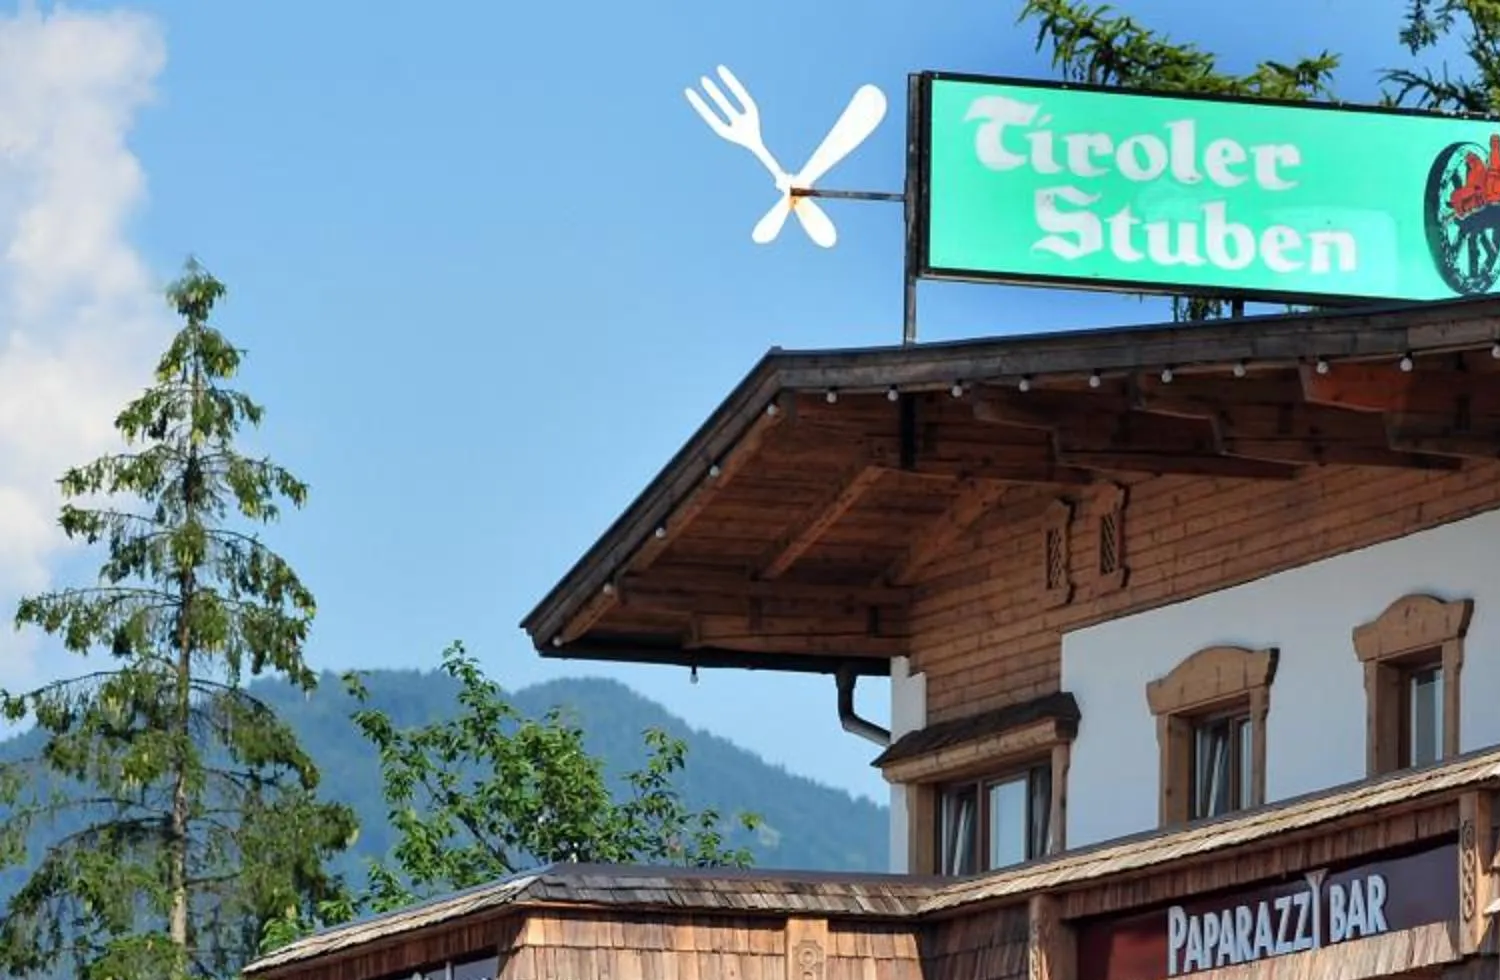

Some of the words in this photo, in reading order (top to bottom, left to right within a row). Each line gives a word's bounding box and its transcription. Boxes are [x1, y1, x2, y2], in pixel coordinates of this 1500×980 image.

[963, 94, 1301, 190] Tiroler
[1030, 185, 1358, 274] Stuben
[1166, 868, 1328, 975] PAPARAZZI
[1329, 874, 1388, 942] BAR
